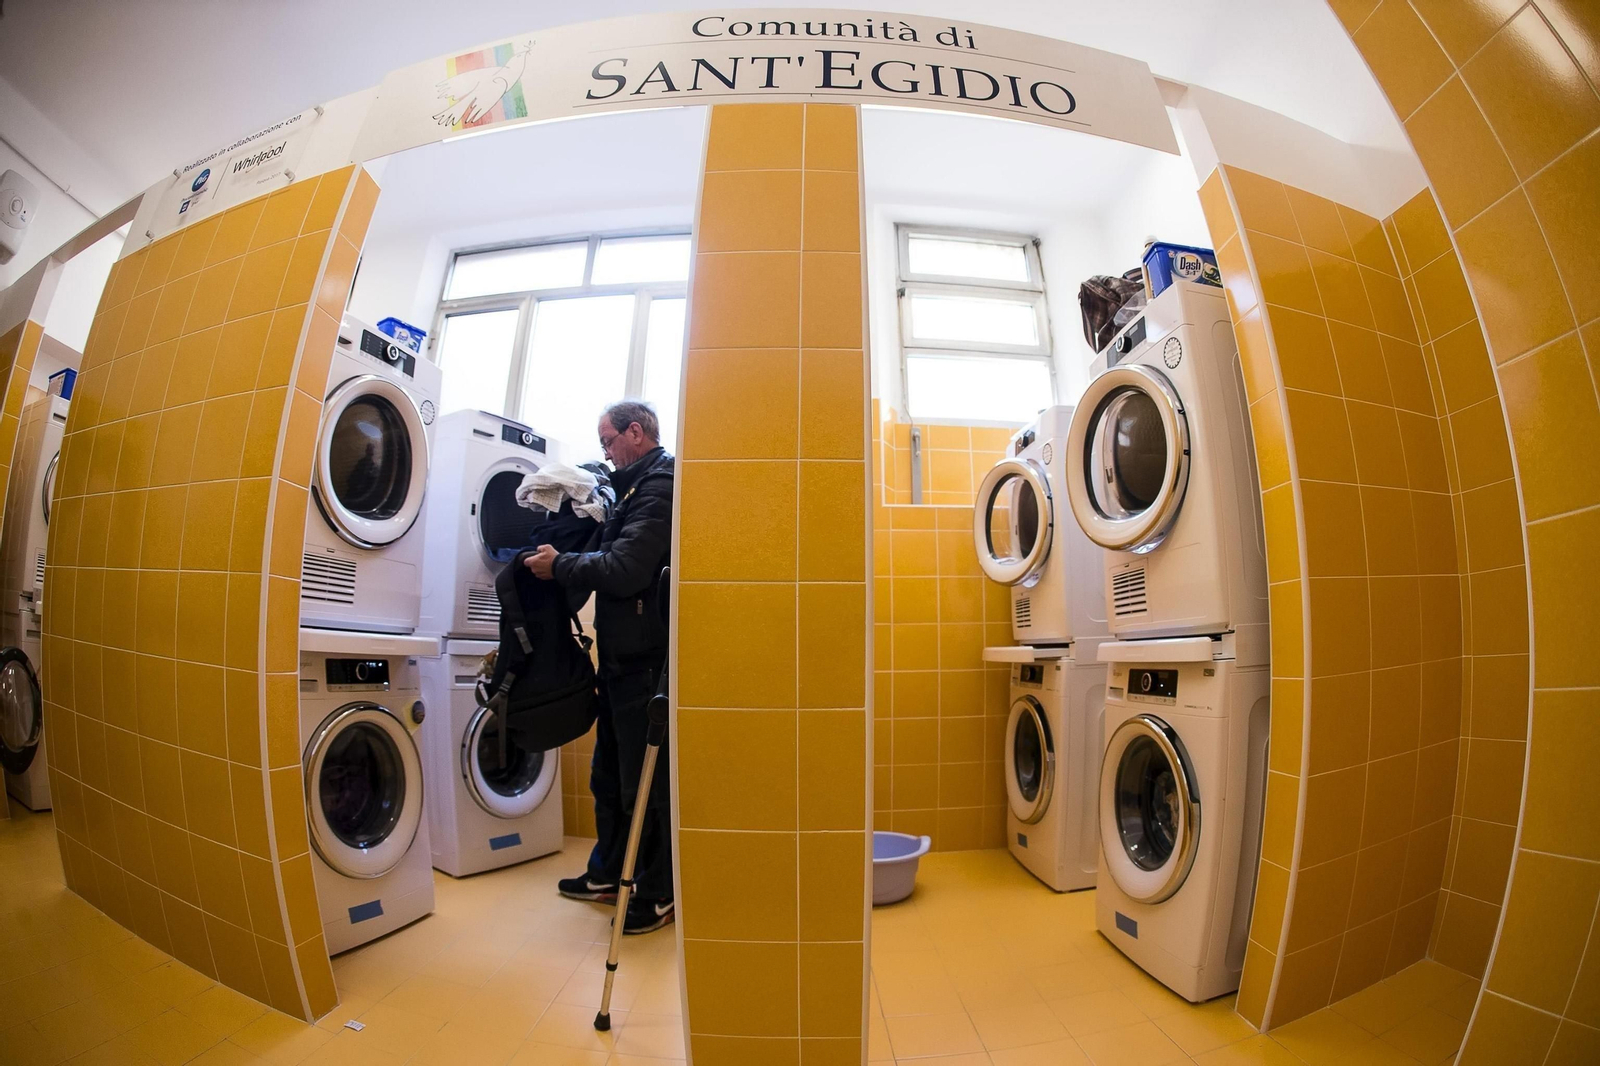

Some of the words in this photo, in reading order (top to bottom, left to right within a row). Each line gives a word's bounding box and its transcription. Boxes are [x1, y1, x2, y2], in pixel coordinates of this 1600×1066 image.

[691, 16, 920, 43] Comunità
[936, 26, 979, 51] di
[182, 153, 218, 173] Realizzato
[218, 149, 226, 157] in
[227, 122, 284, 152] collaborazione
[285, 114, 302, 126] con
[232, 140, 287, 173] Whirlpool
[1180, 256, 1201, 271] Dash
